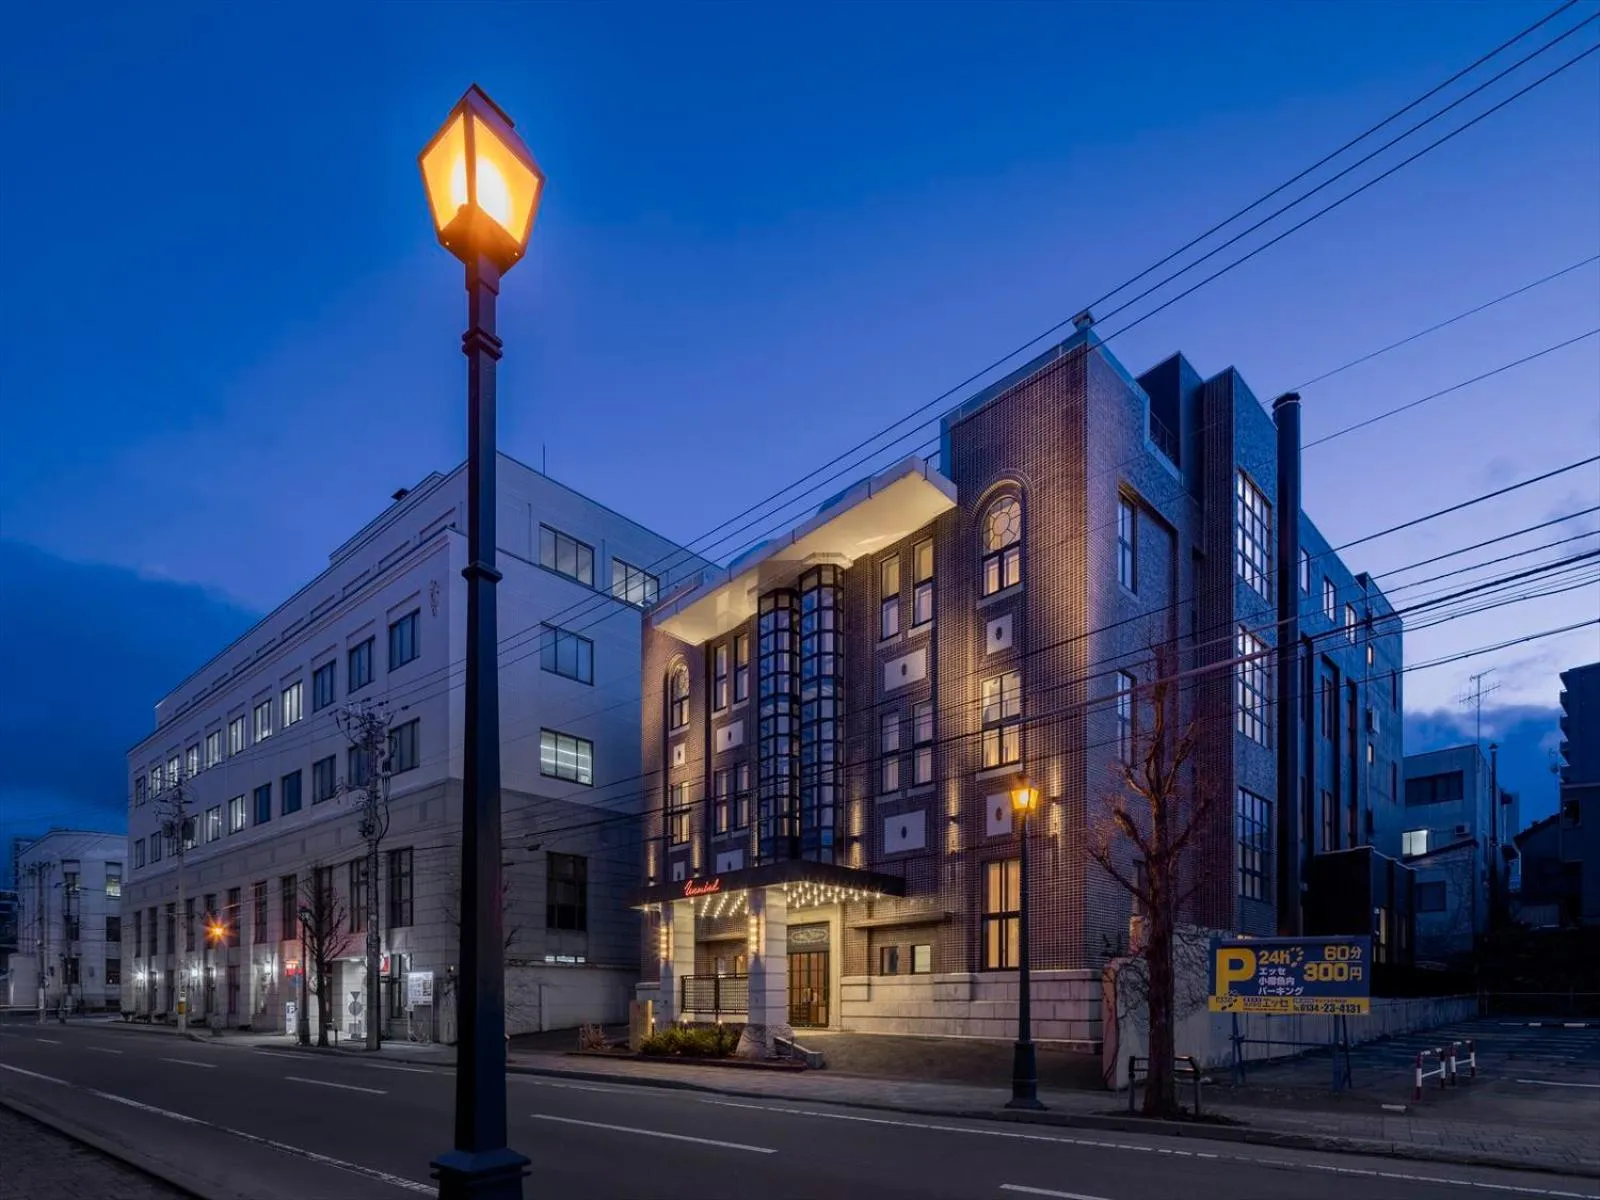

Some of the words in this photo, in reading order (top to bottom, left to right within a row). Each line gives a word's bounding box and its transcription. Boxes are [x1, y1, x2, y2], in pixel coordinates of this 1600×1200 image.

[1324, 945, 1362, 960] 60分
[1216, 948, 1257, 996] P
[1258, 967, 1286, 976] エッセ
[1303, 963, 1362, 982] 300円
[1258, 986, 1304, 996] パーキング
